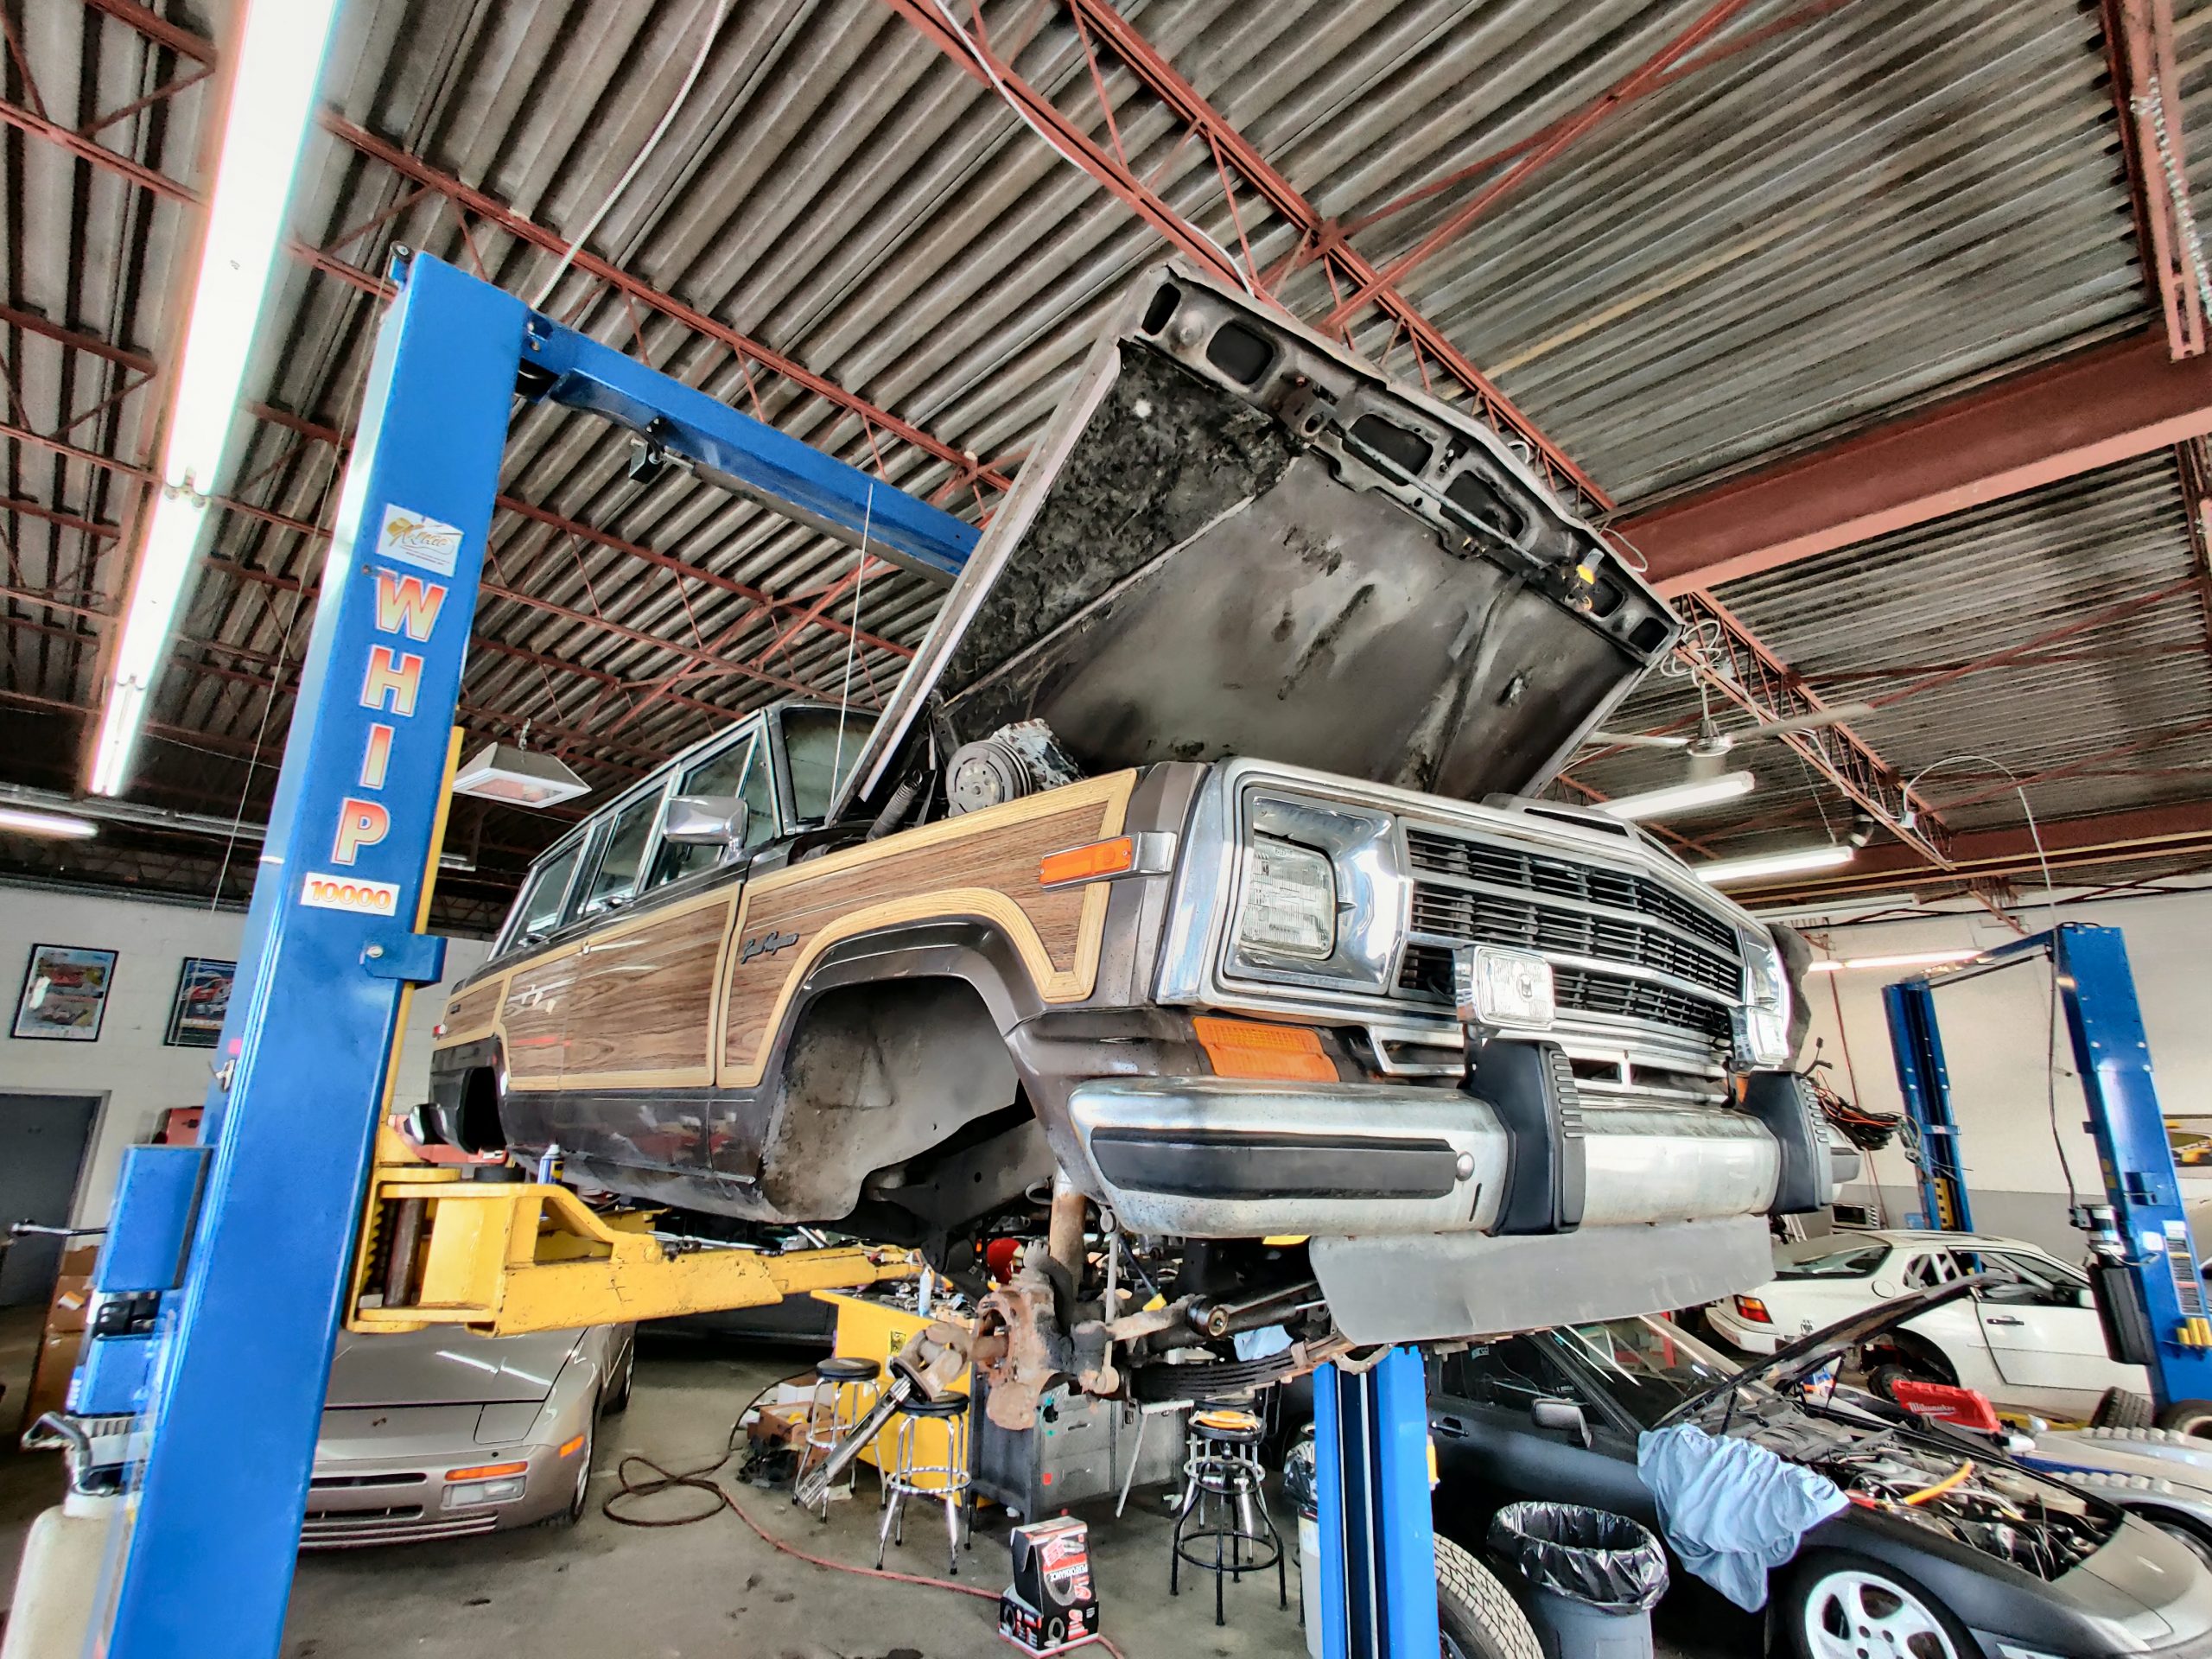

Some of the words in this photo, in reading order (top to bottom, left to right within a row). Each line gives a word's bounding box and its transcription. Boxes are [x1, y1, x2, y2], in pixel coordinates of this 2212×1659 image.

[331, 567, 448, 867] WHIP
[311, 880, 392, 910] 10000
[1049, 1564, 1089, 1582] PERFORMANCE
